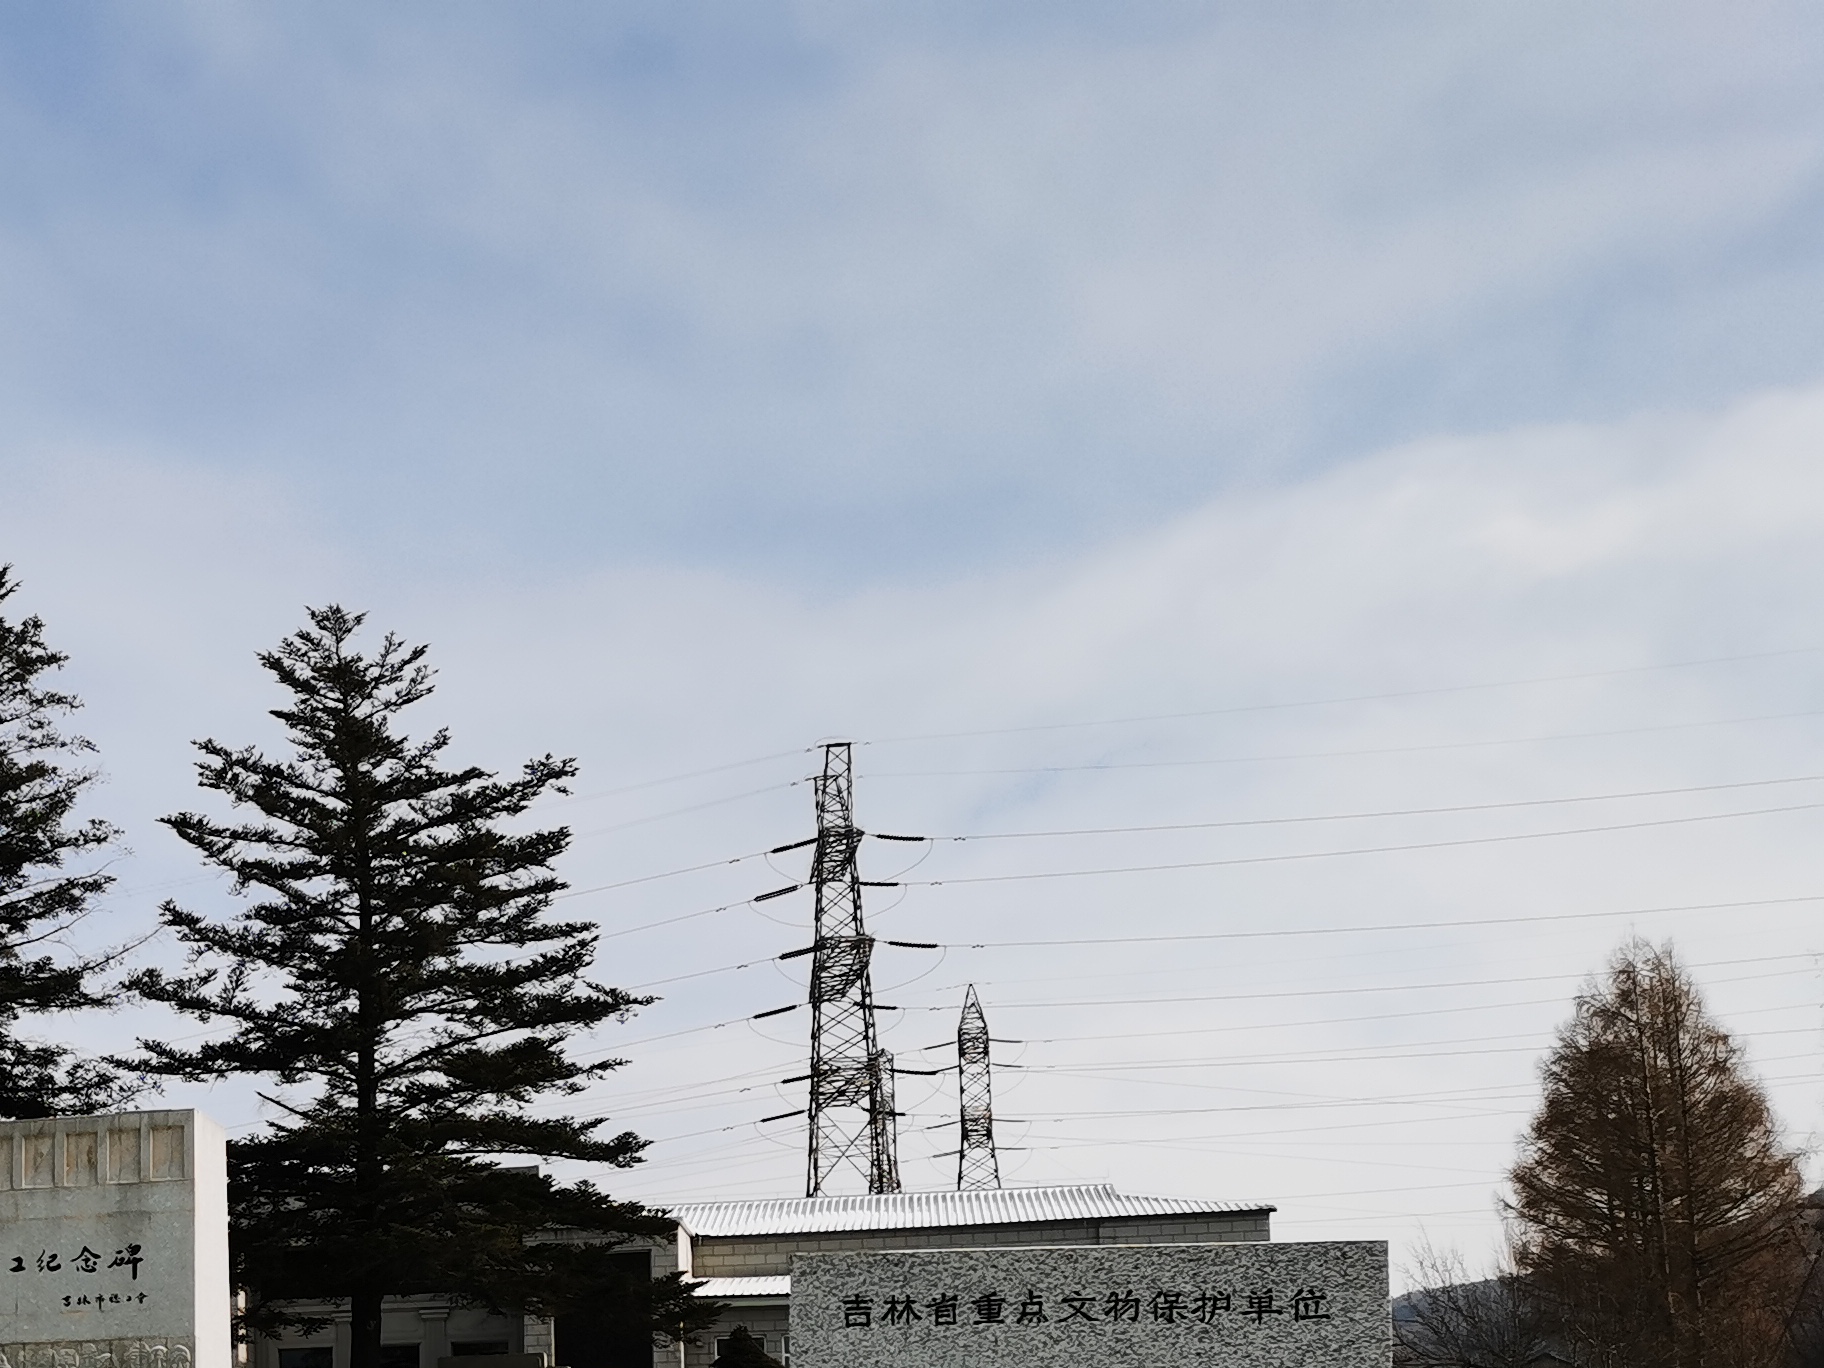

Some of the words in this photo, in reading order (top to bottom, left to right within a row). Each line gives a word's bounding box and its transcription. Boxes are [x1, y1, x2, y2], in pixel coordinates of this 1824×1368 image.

[841, 1287, 1332, 1328] 吉林省重点文物保护单位
